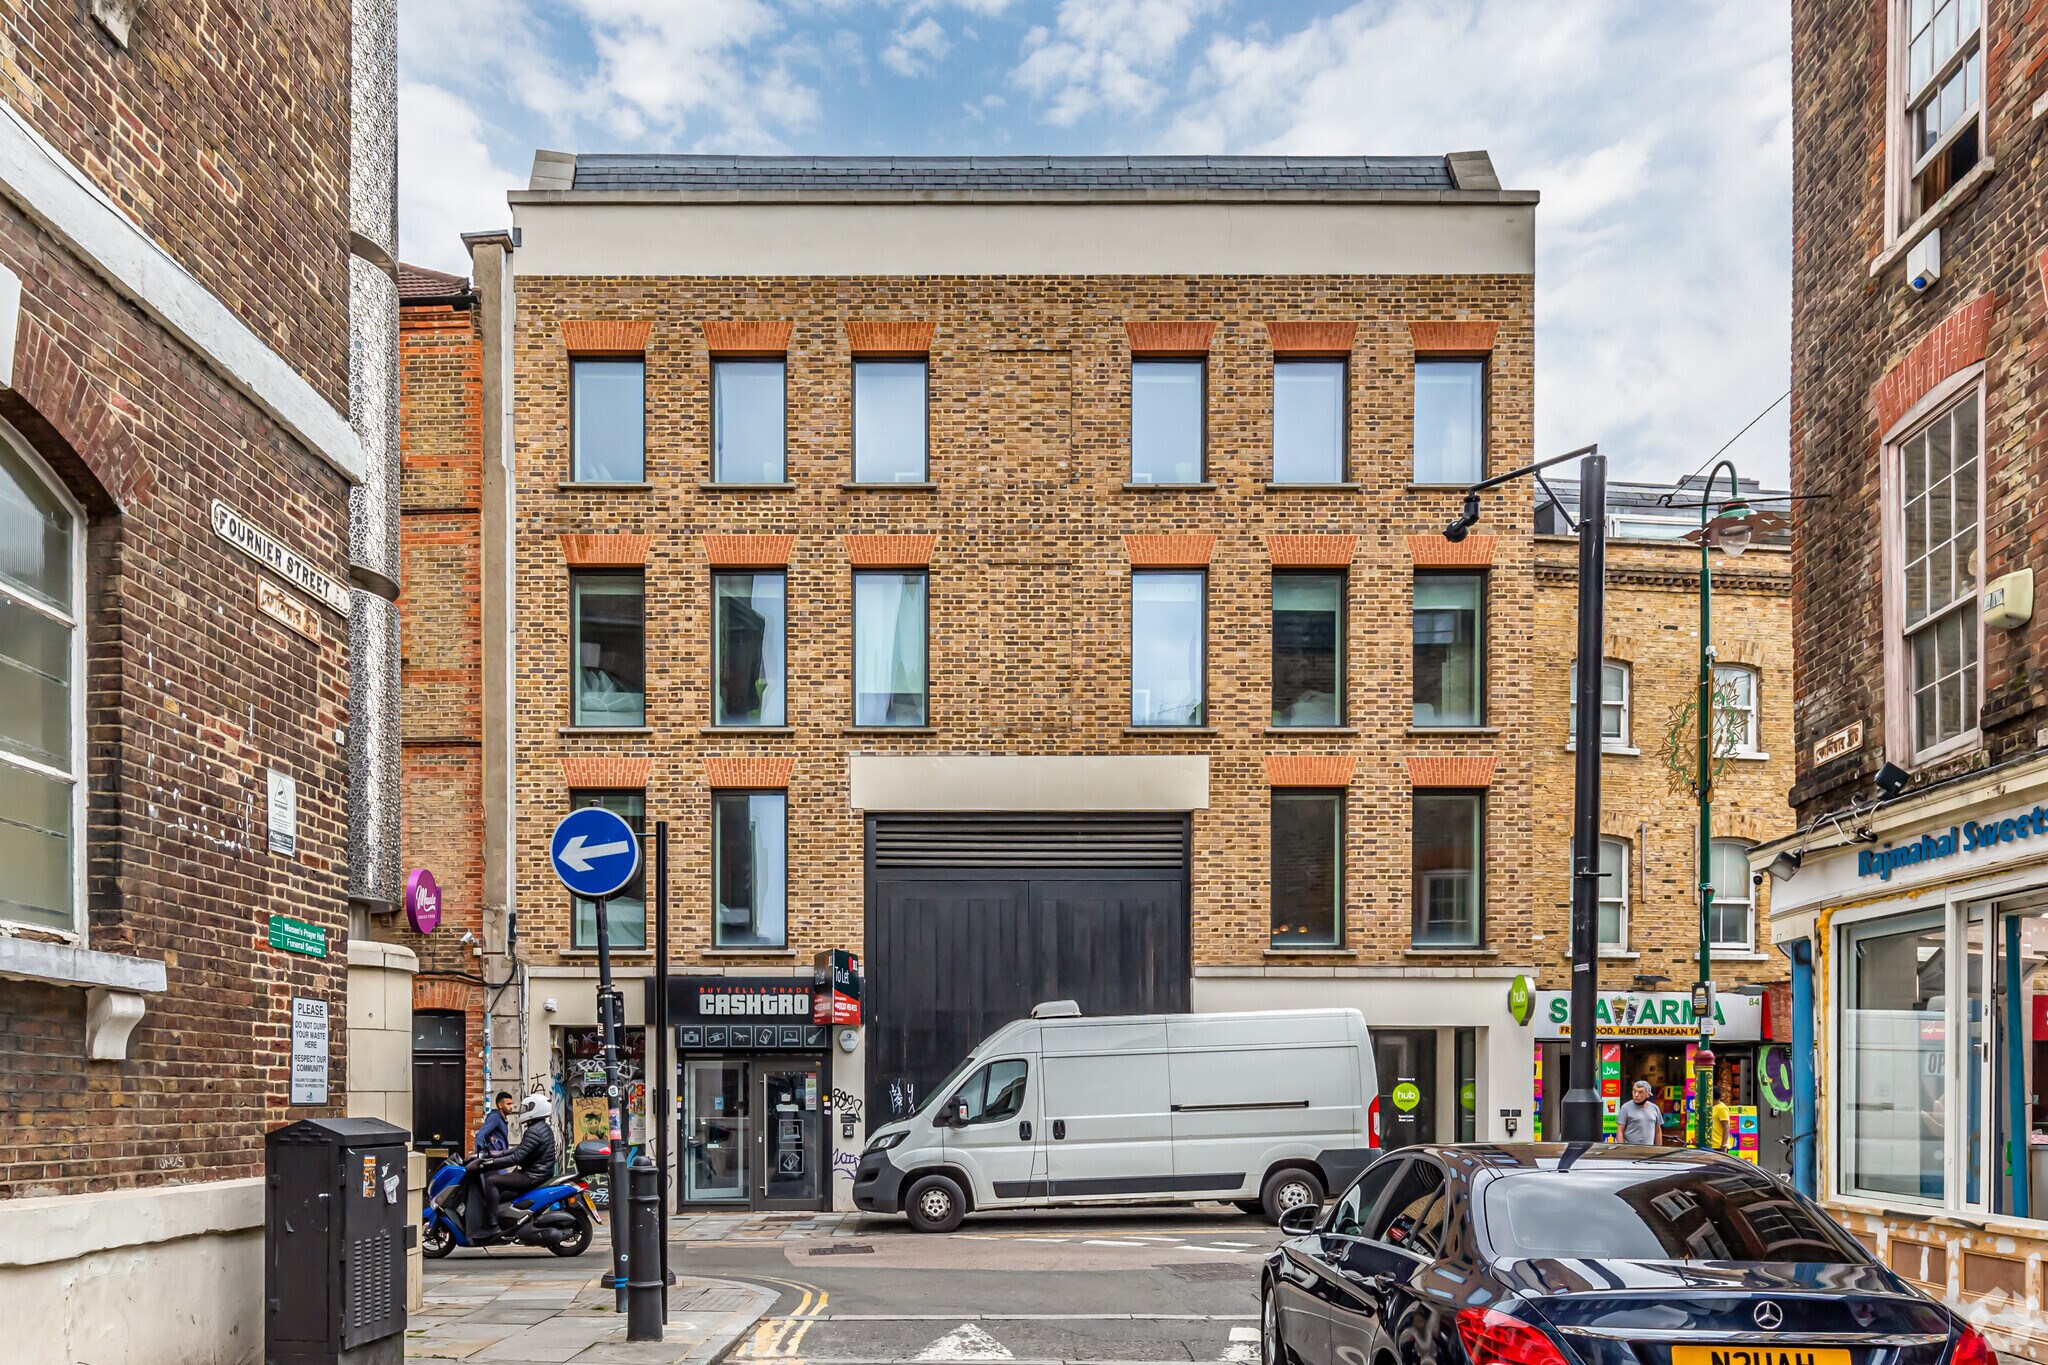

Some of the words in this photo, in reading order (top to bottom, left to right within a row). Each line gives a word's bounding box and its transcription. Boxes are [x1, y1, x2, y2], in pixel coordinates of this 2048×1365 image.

[218, 510, 282, 568] FOURNIER
[286, 556, 330, 598] STREET
[1858, 826, 1957, 880] Rajmahal
[284, 923, 303, 936] Women's
[303, 928, 317, 940] Prayer
[286, 938, 304, 950] Funeral
[305, 943, 322, 954] Service
[835, 966, 841, 983] To
[1512, 988, 1526, 1004] hub
[1749, 998, 1760, 1006] 84
[298, 1003, 324, 1016] PLEASE
[303, 1021, 313, 1029] NOT
[313, 1022, 326, 1030] DUMP
[1596, 1027, 1616, 1035] OOD,
[296, 1030, 309, 1038] YOUR
[310, 1032, 326, 1040] WASTE
[294, 1054, 316, 1063] RESPECT
[1397, 1090, 1416, 1099] hub
